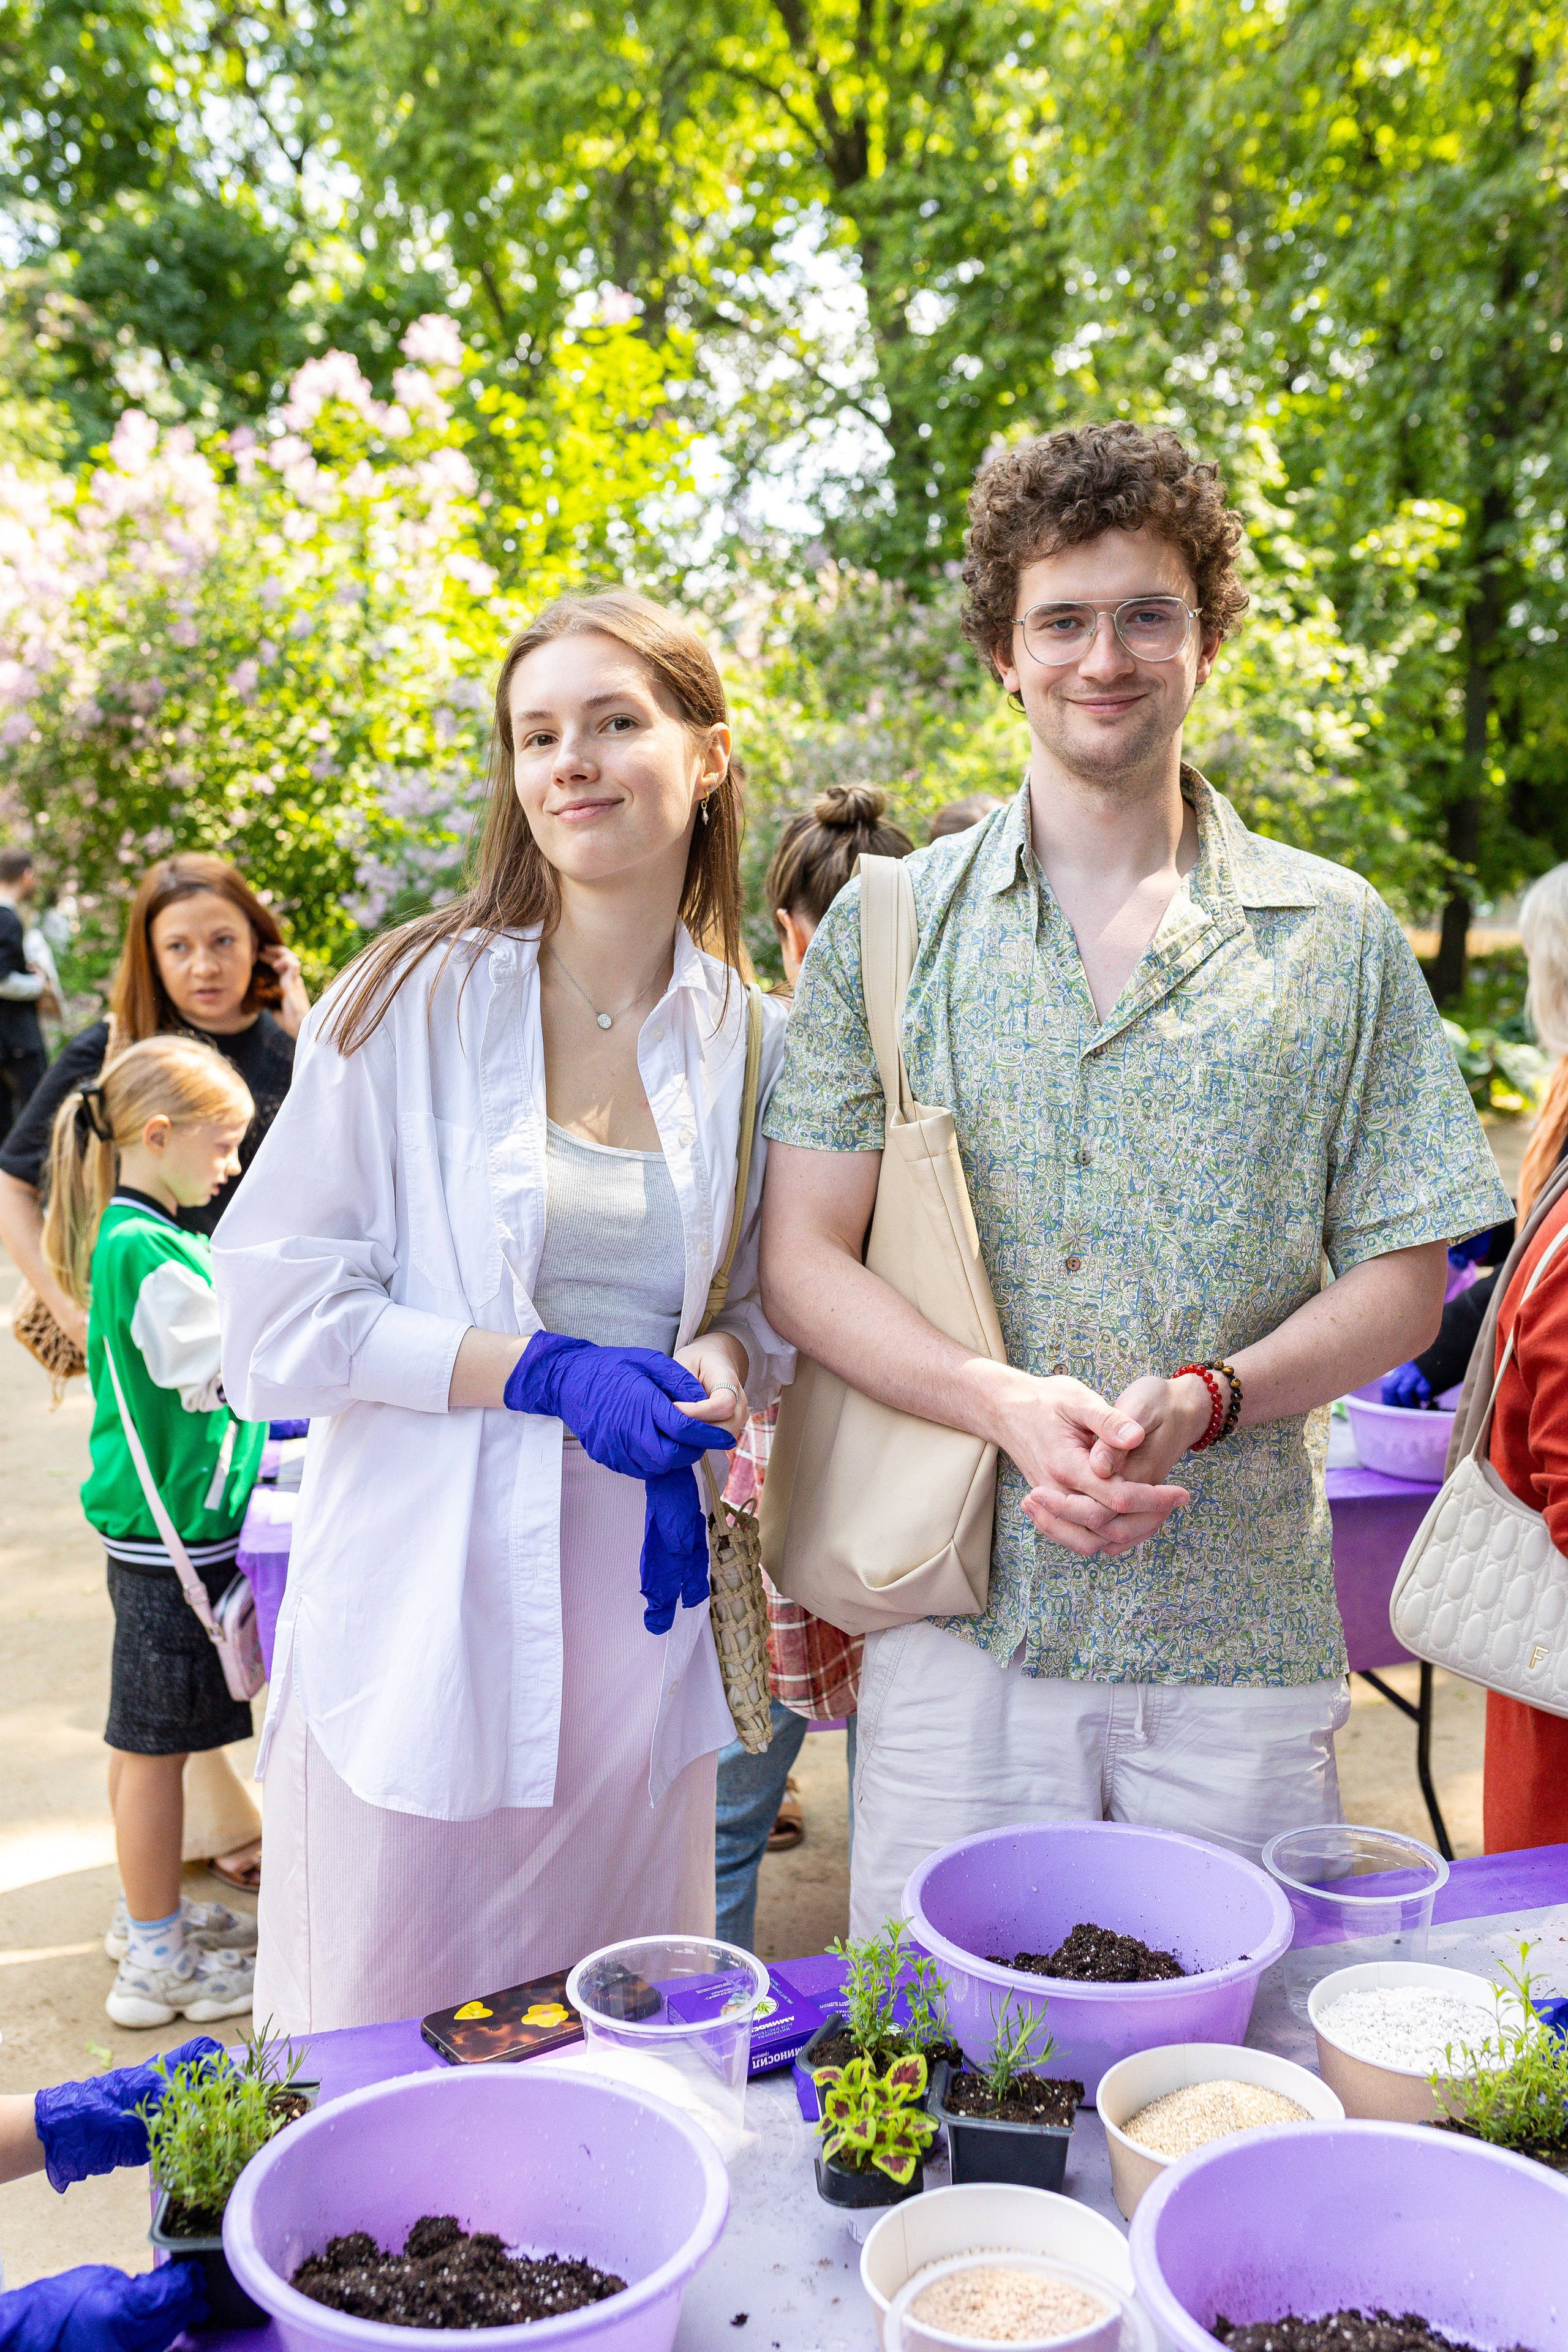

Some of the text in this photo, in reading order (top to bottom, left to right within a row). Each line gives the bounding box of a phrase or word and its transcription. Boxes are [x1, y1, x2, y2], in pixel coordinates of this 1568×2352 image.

[1529, 1645, 1550, 1669] F
[751, 2015, 795, 2033] АМИНОС
[752, 2045, 805, 2070] МИНОСИЛ
